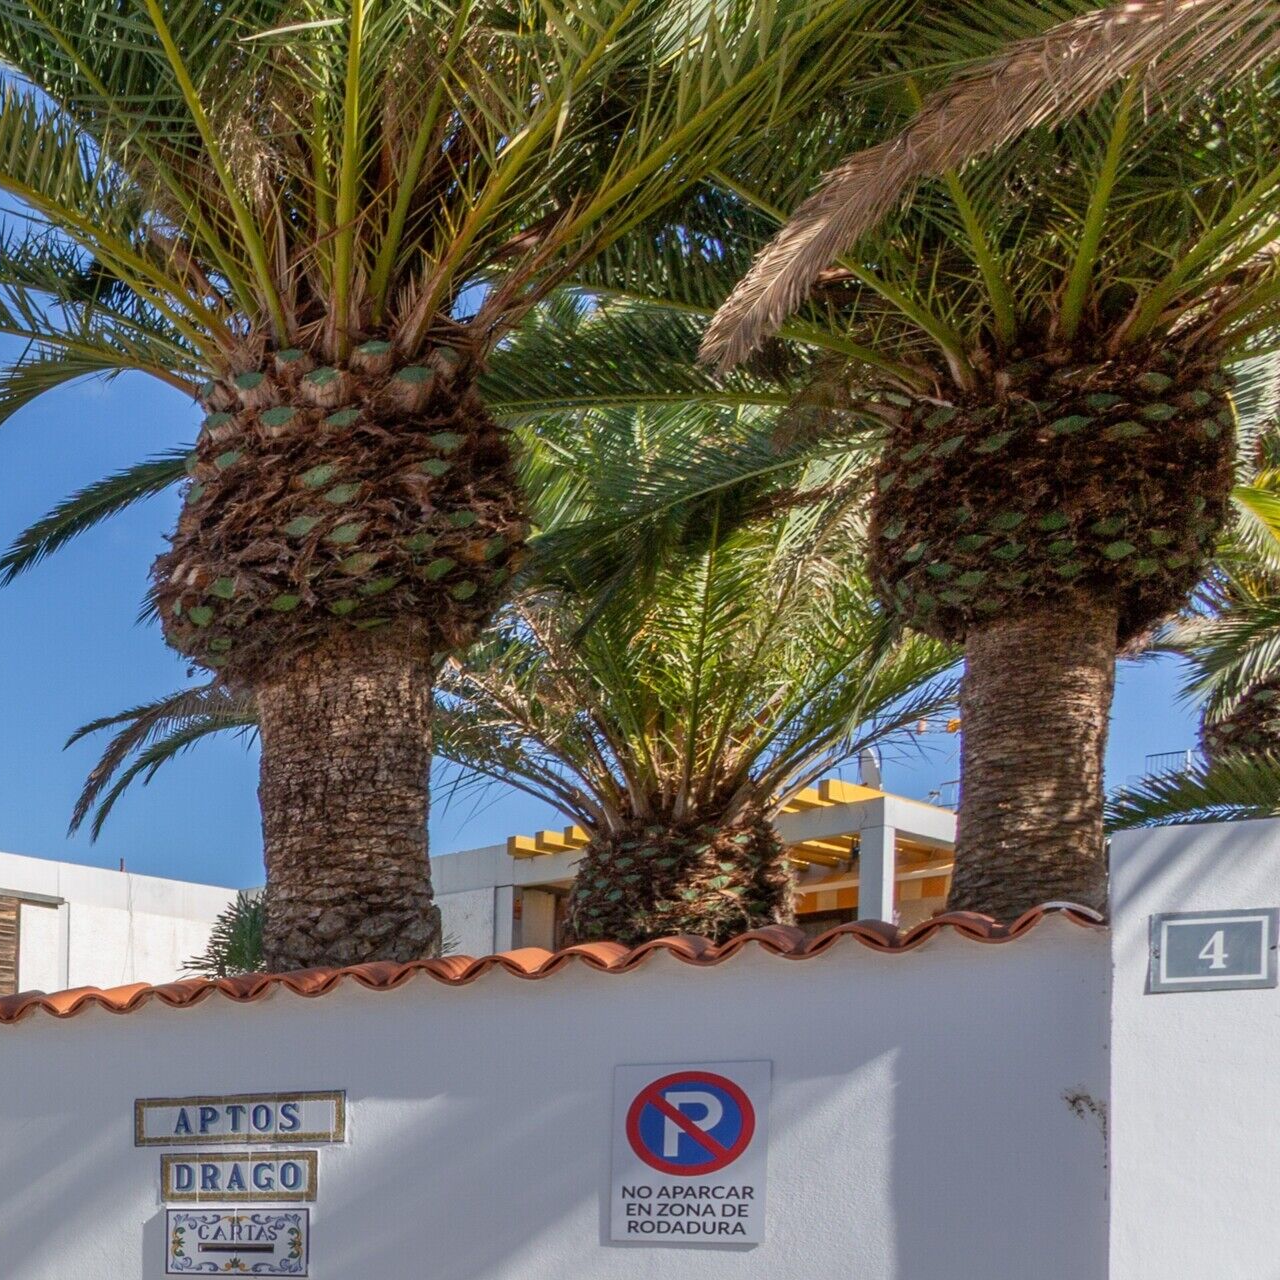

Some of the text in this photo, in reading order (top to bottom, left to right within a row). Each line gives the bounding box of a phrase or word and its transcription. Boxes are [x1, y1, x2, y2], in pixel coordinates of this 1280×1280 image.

[1198, 930, 1229, 969] 4
[174, 1103, 302, 1135] APTOS
[174, 1162, 303, 1191] DRAGO
[621, 1185, 755, 1200] NO APARCAR
[625, 1203, 750, 1218] EN ZONA DE
[197, 1223, 277, 1241] CARTAS
[627, 1220, 747, 1235] RODADURA
